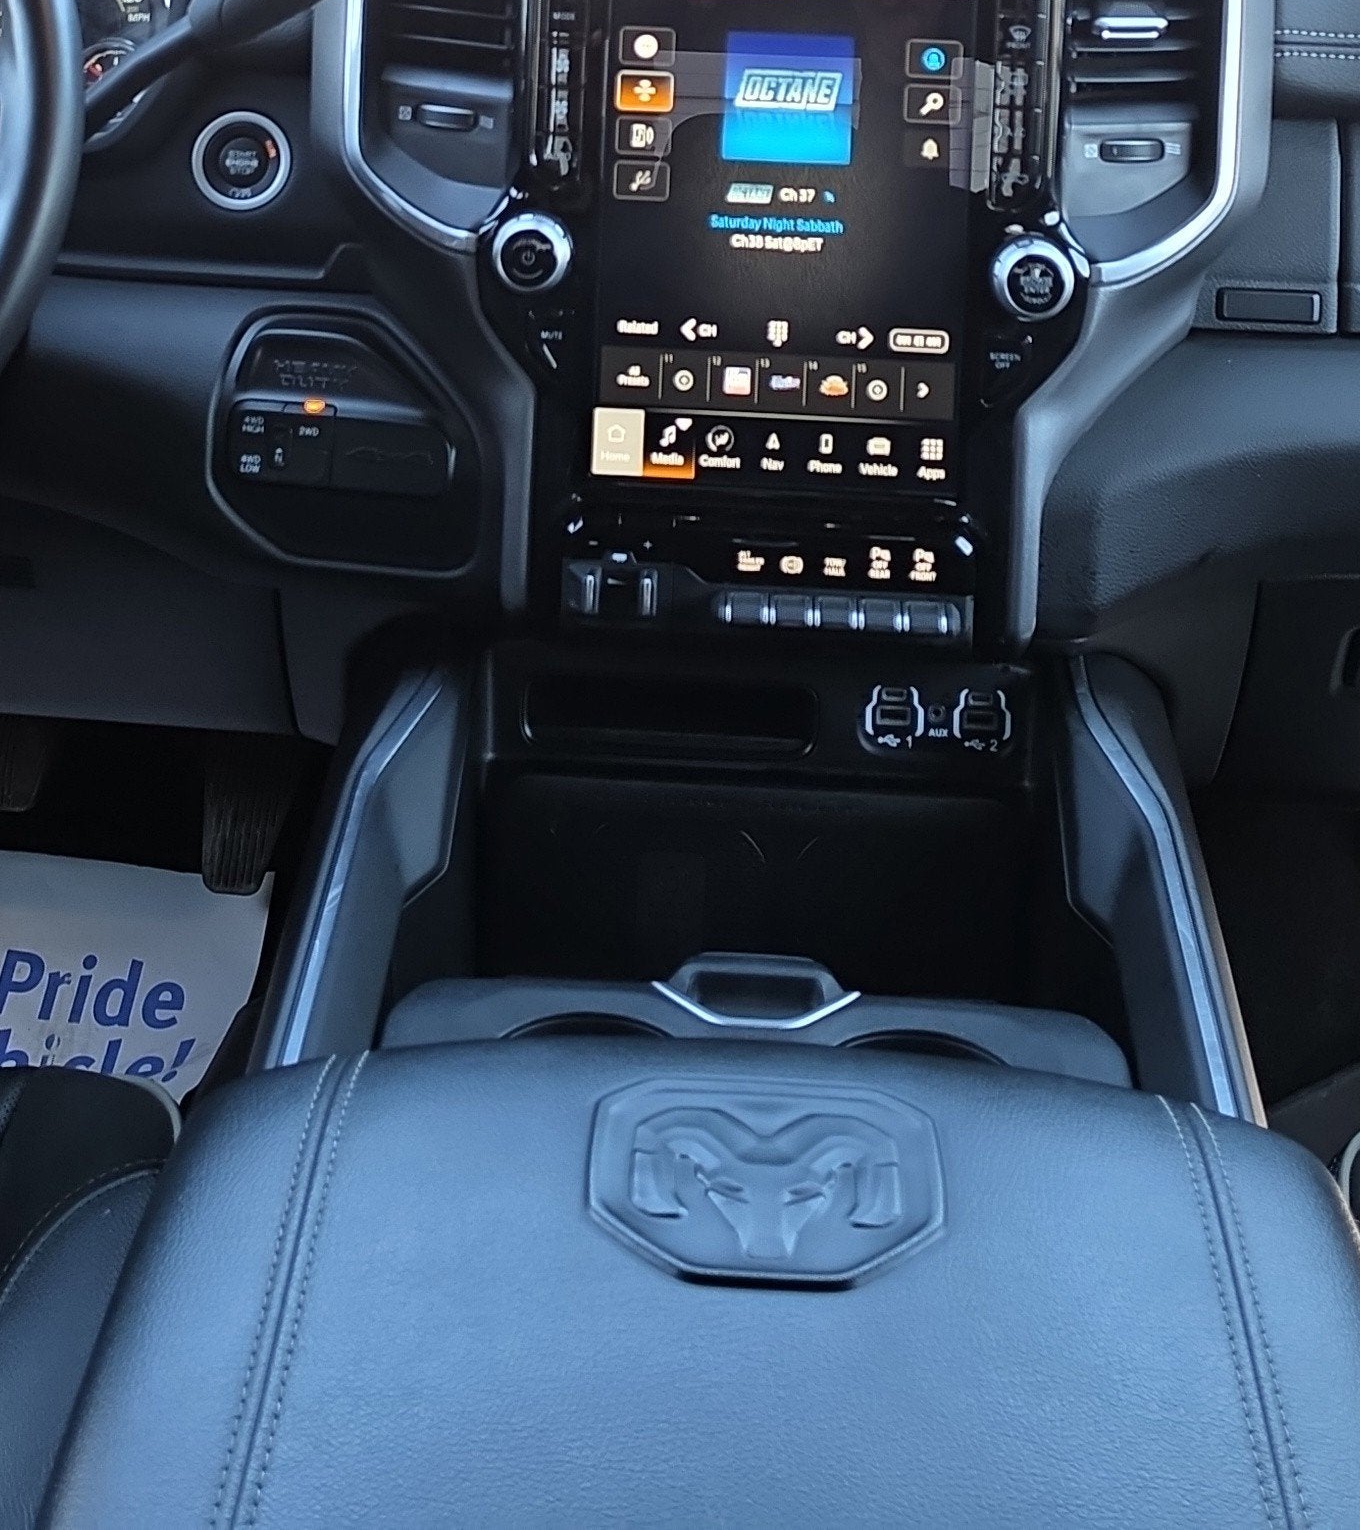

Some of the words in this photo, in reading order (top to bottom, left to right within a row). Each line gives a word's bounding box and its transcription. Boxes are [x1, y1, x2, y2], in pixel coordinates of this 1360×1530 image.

[742, 74, 835, 104] OCTANE
[779, 188, 797, 203] Ch
[798, 189, 816, 203] 37
[710, 214, 761, 231] Saturday
[763, 217, 795, 233] Night
[796, 218, 844, 234] Sabbath
[541, 331, 562, 340] MUTE
[242, 415, 265, 425] 4WD
[241, 424, 265, 434] HIGH
[299, 426, 320, 437] 2WD
[240, 454, 261, 463] 4WD
[601, 451, 631, 463] Home
[649, 452, 685, 466] Media
[698, 454, 741, 469] Comfort
[760, 456, 785, 472] Nav
[239, 463, 261, 474] LOW
[807, 459, 843, 475] Phone
[858, 462, 899, 478] Vehicle
[916, 466, 946, 481] Apps
[928, 728, 948, 738] AUX
[905, 735, 913, 750] 1
[989, 739, 999, 753] 2
